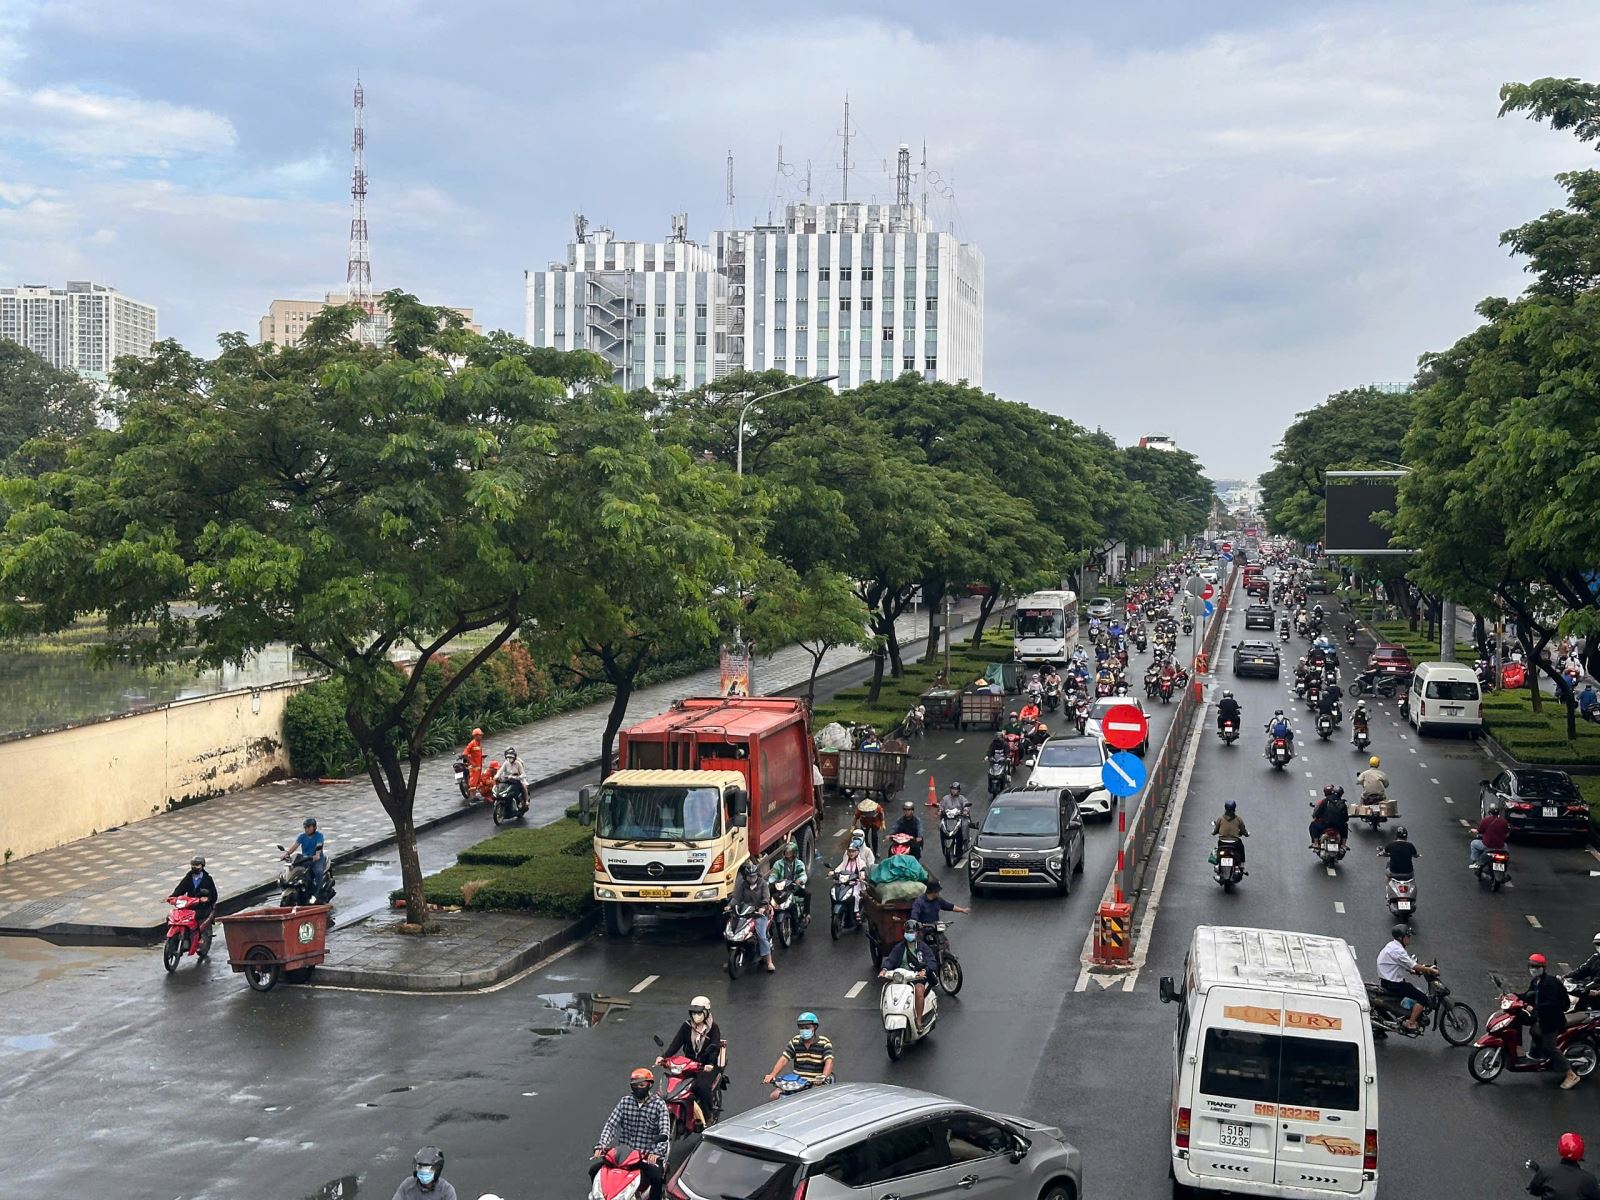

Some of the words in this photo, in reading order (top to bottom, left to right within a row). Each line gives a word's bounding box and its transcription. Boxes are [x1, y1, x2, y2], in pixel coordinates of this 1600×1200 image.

[1207, 1100, 1237, 1109] TRANSIT
[1227, 1125, 1244, 1136] 51B
[1220, 1134, 1249, 1147] 332.35
